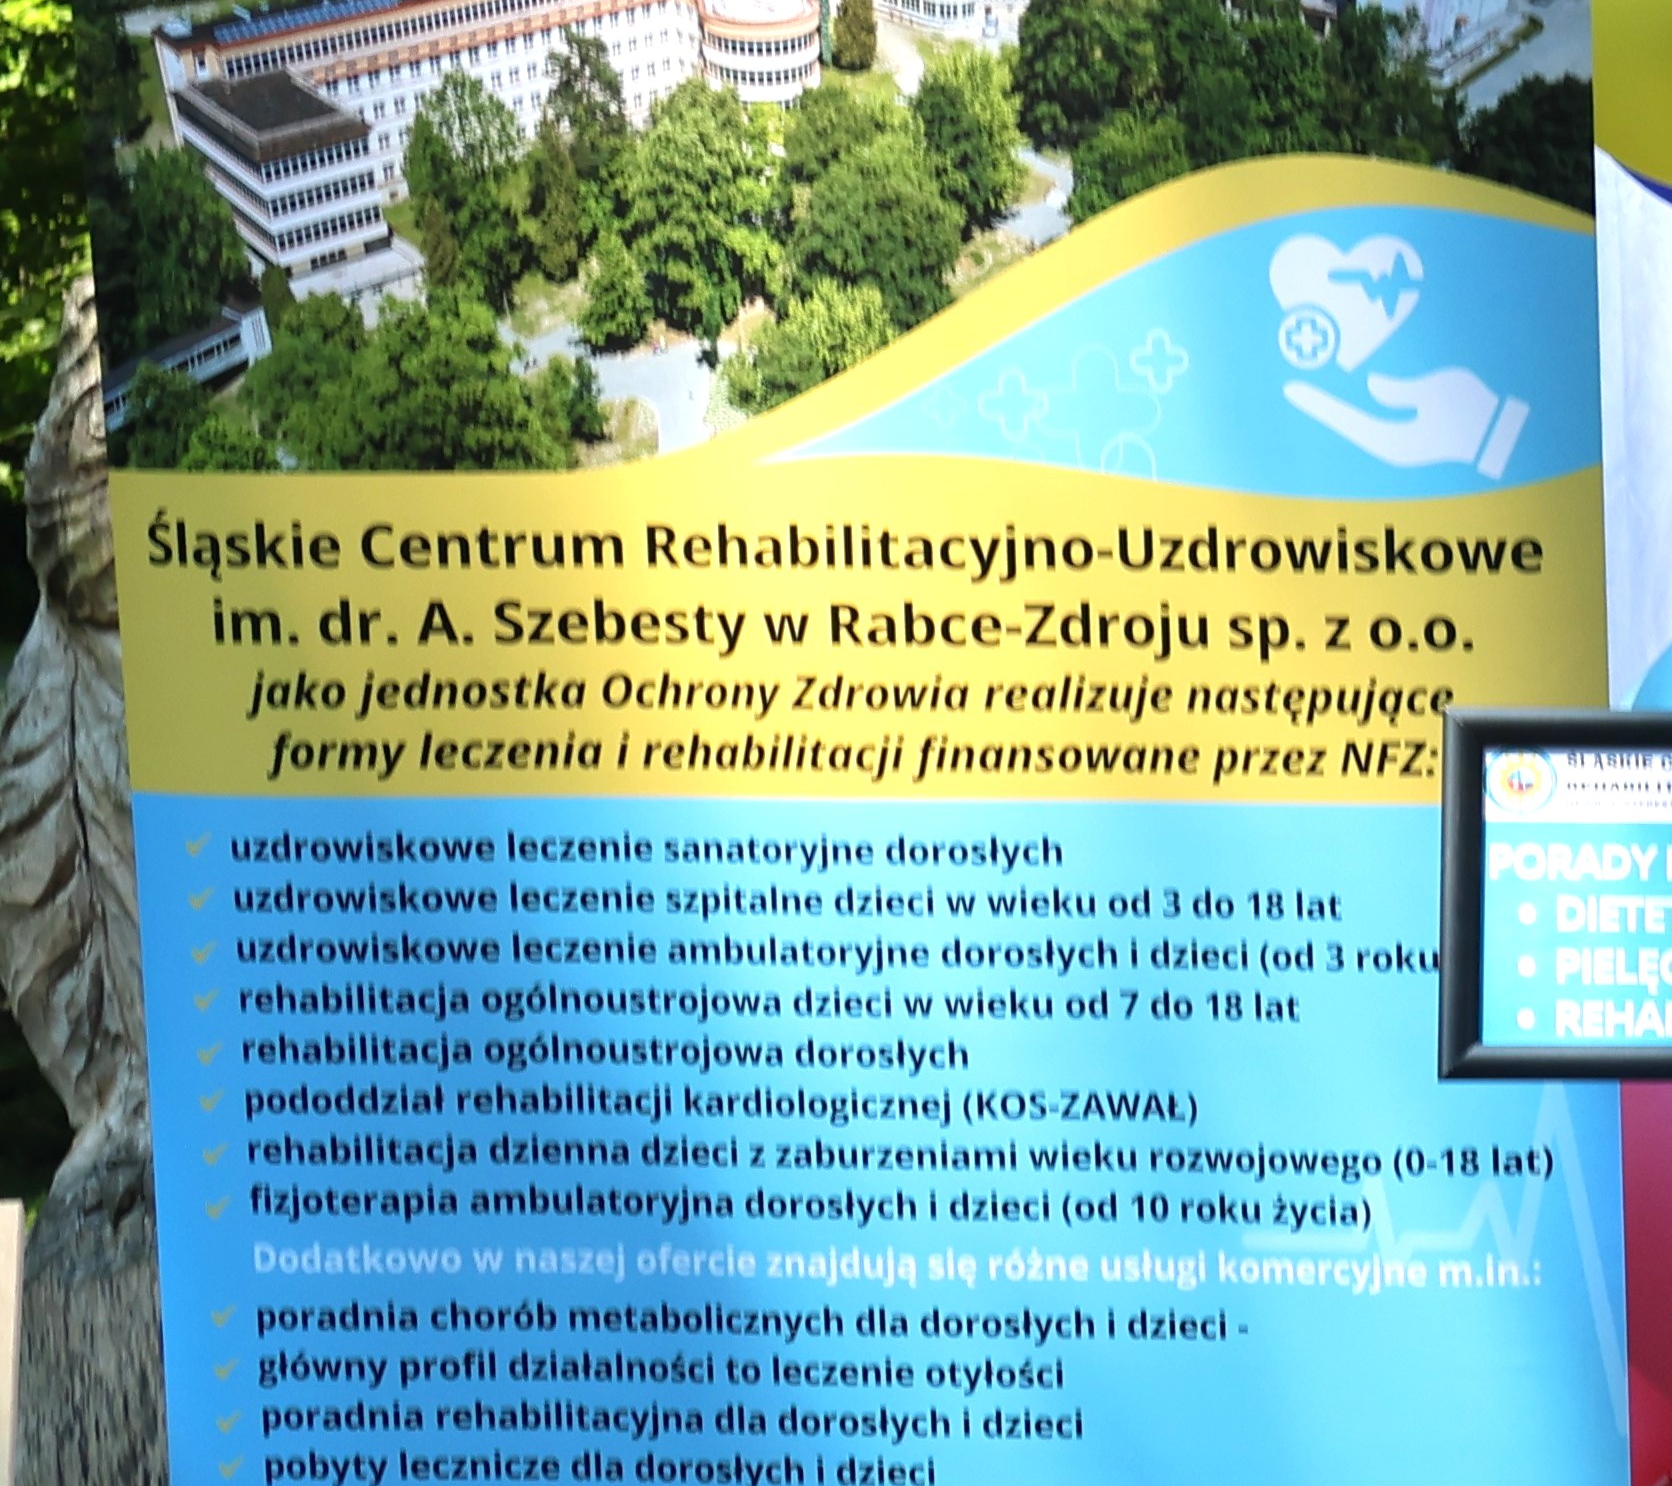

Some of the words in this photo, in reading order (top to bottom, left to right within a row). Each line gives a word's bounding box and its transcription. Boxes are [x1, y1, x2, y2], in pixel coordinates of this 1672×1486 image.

[147, 509, 341, 581] Śląskie
[361, 524, 624, 569] Centrum
[646, 523, 1544, 583] Rehabilitacyjno-Uzdrowiskowe
[213, 597, 299, 645] im.
[319, 598, 398, 645] dr.
[418, 600, 474, 646] A.
[494, 597, 746, 658] Szebesty
[763, 613, 809, 644] w
[830, 601, 1209, 662] Rabce-Zdroju
[1228, 615, 1306, 664] sp.
[1325, 616, 1351, 651] z
[1369, 615, 1474, 652] o.o.
[248, 671, 346, 719] jako
[355, 670, 586, 721] jednostka
[602, 672, 780, 719] Ochrony
[792, 674, 969, 711] Zdrowia
[985, 674, 1173, 724] realizuje
[1187, 677, 1454, 729] następujące
[268, 733, 406, 781] formy
[419, 731, 602, 770] leczenia
[617, 731, 630, 769] i
[643, 733, 904, 782] rehabilitacji
[916, 736, 1200, 782] finansowane
[1212, 747, 1327, 785] przez
[1341, 740, 1438, 777] NFZ:
[231, 831, 495, 862] uzdrowiskowe
[507, 830, 653, 863] leczenie
[664, 835, 874, 873] sanatoryjne
[885, 835, 1063, 874] dorosłych
[1487, 843, 1657, 882] PORADY
[242, 1032, 472, 1072] rehabilitacja
[484, 1032, 784, 1076] ogólnoustrojowa
[795, 1036, 969, 1077] dorosłych
[245, 1083, 444, 1122] pododdział
[457, 1082, 672, 1125] rehabilitacji
[684, 1085, 951, 1128] kardiologicznej
[963, 1090, 1198, 1127] (KOS-ZAWAŁ)
[248, 1133, 477, 1172] rehabilitacja
[489, 1133, 630, 1166] dzienna
[641, 1134, 738, 1167] dzieci
[750, 1145, 765, 1168] z
[776, 1137, 1017, 1171] zaburzeniami
[1028, 1139, 1137, 1172] wieku
[1150, 1143, 1382, 1183] rozwojowego
[1393, 1146, 1480, 1182] (0-18
[1492, 1145, 1554, 1182] lat)
[258, 1349, 388, 1390] główny
[399, 1349, 497, 1389] profil
[508, 1349, 714, 1385] działalności
[725, 1356, 761, 1386] to
[772, 1353, 915, 1388] leczenie
[925, 1356, 1064, 1398] otyłości
